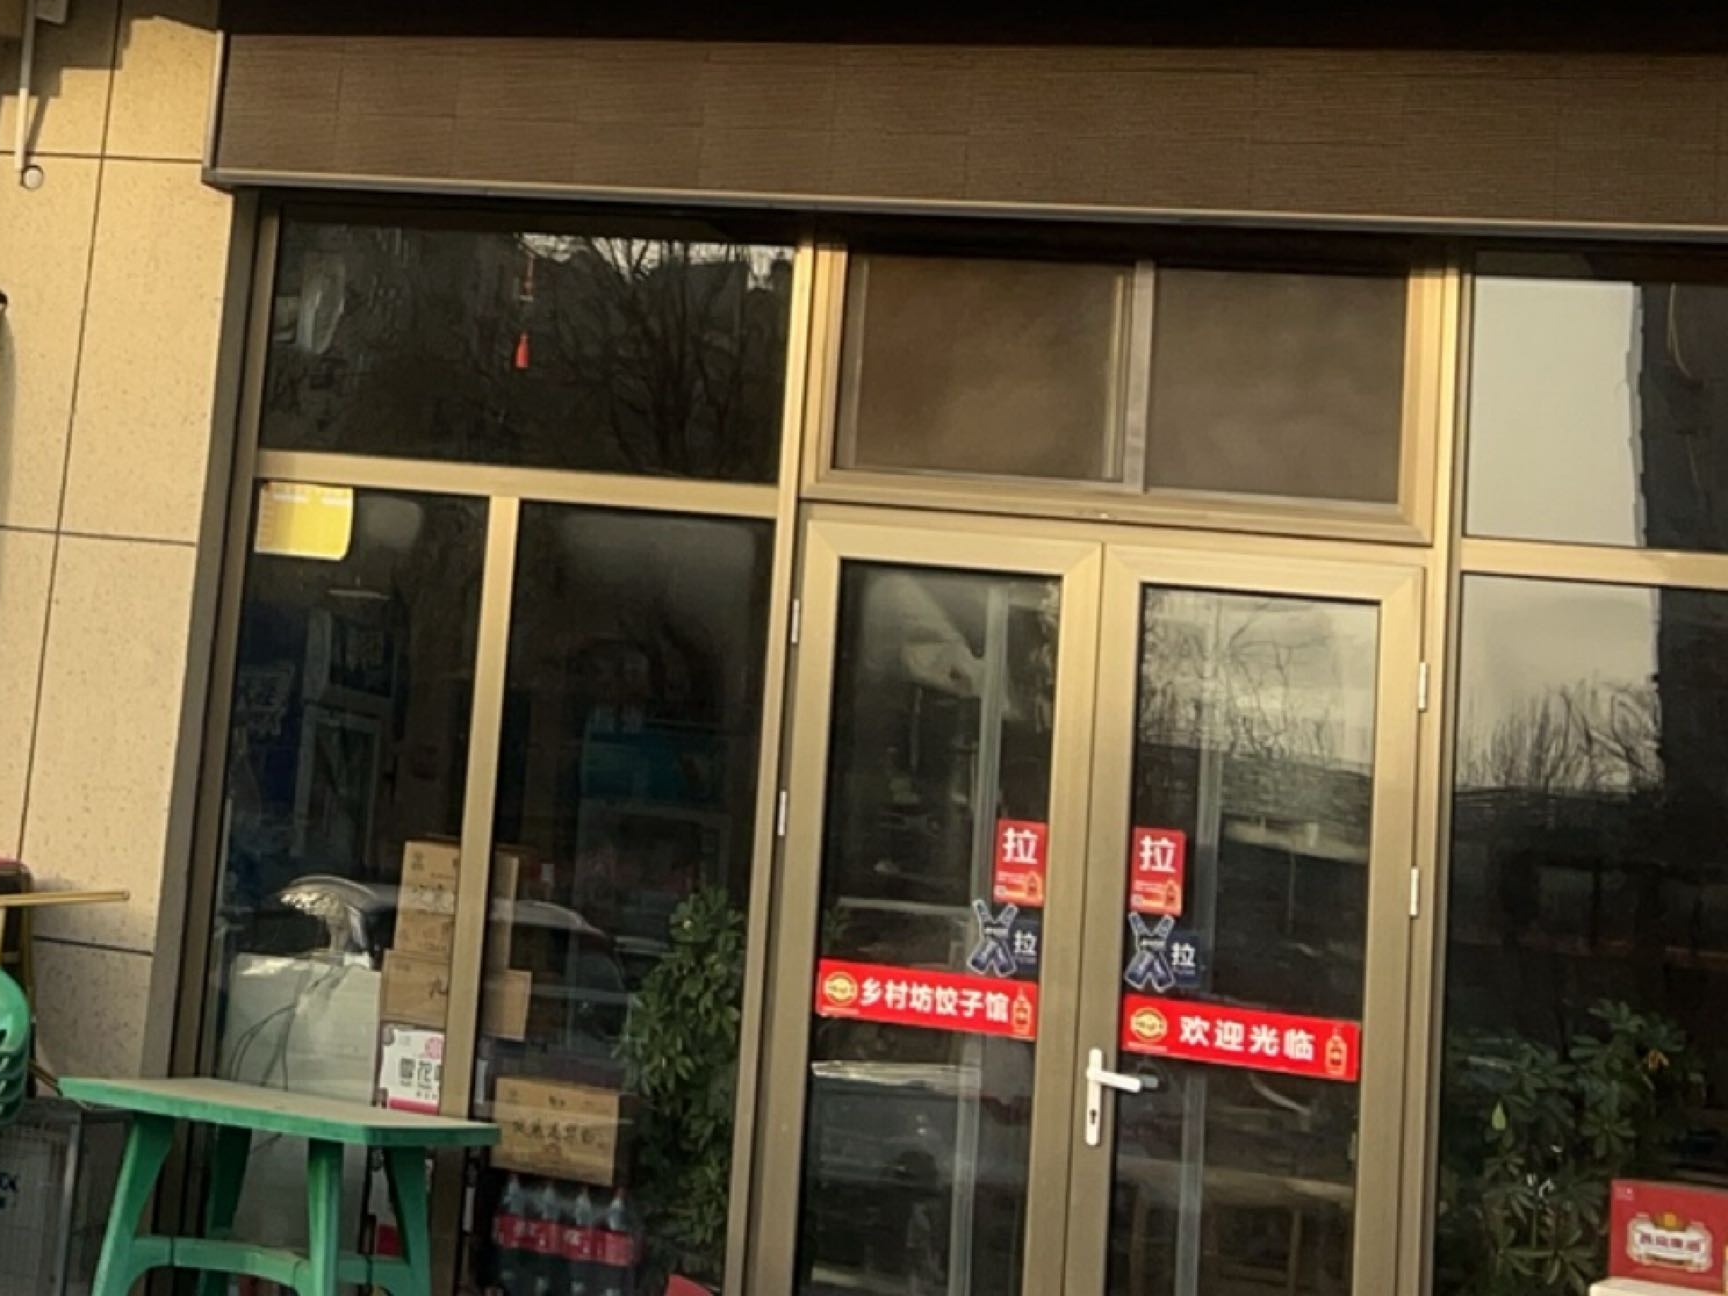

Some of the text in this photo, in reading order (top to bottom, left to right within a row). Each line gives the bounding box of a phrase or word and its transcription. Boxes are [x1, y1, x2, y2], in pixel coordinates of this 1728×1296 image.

[1002, 826, 1039, 865] 拉
[1138, 834, 1177, 873] 拉
[1014, 929, 1038, 954] 拉
[1171, 941, 1196, 967] 拉
[859, 977, 1010, 1023] 乡村坊饺子馆
[1178, 1015, 1316, 1062] 欢迎光临
